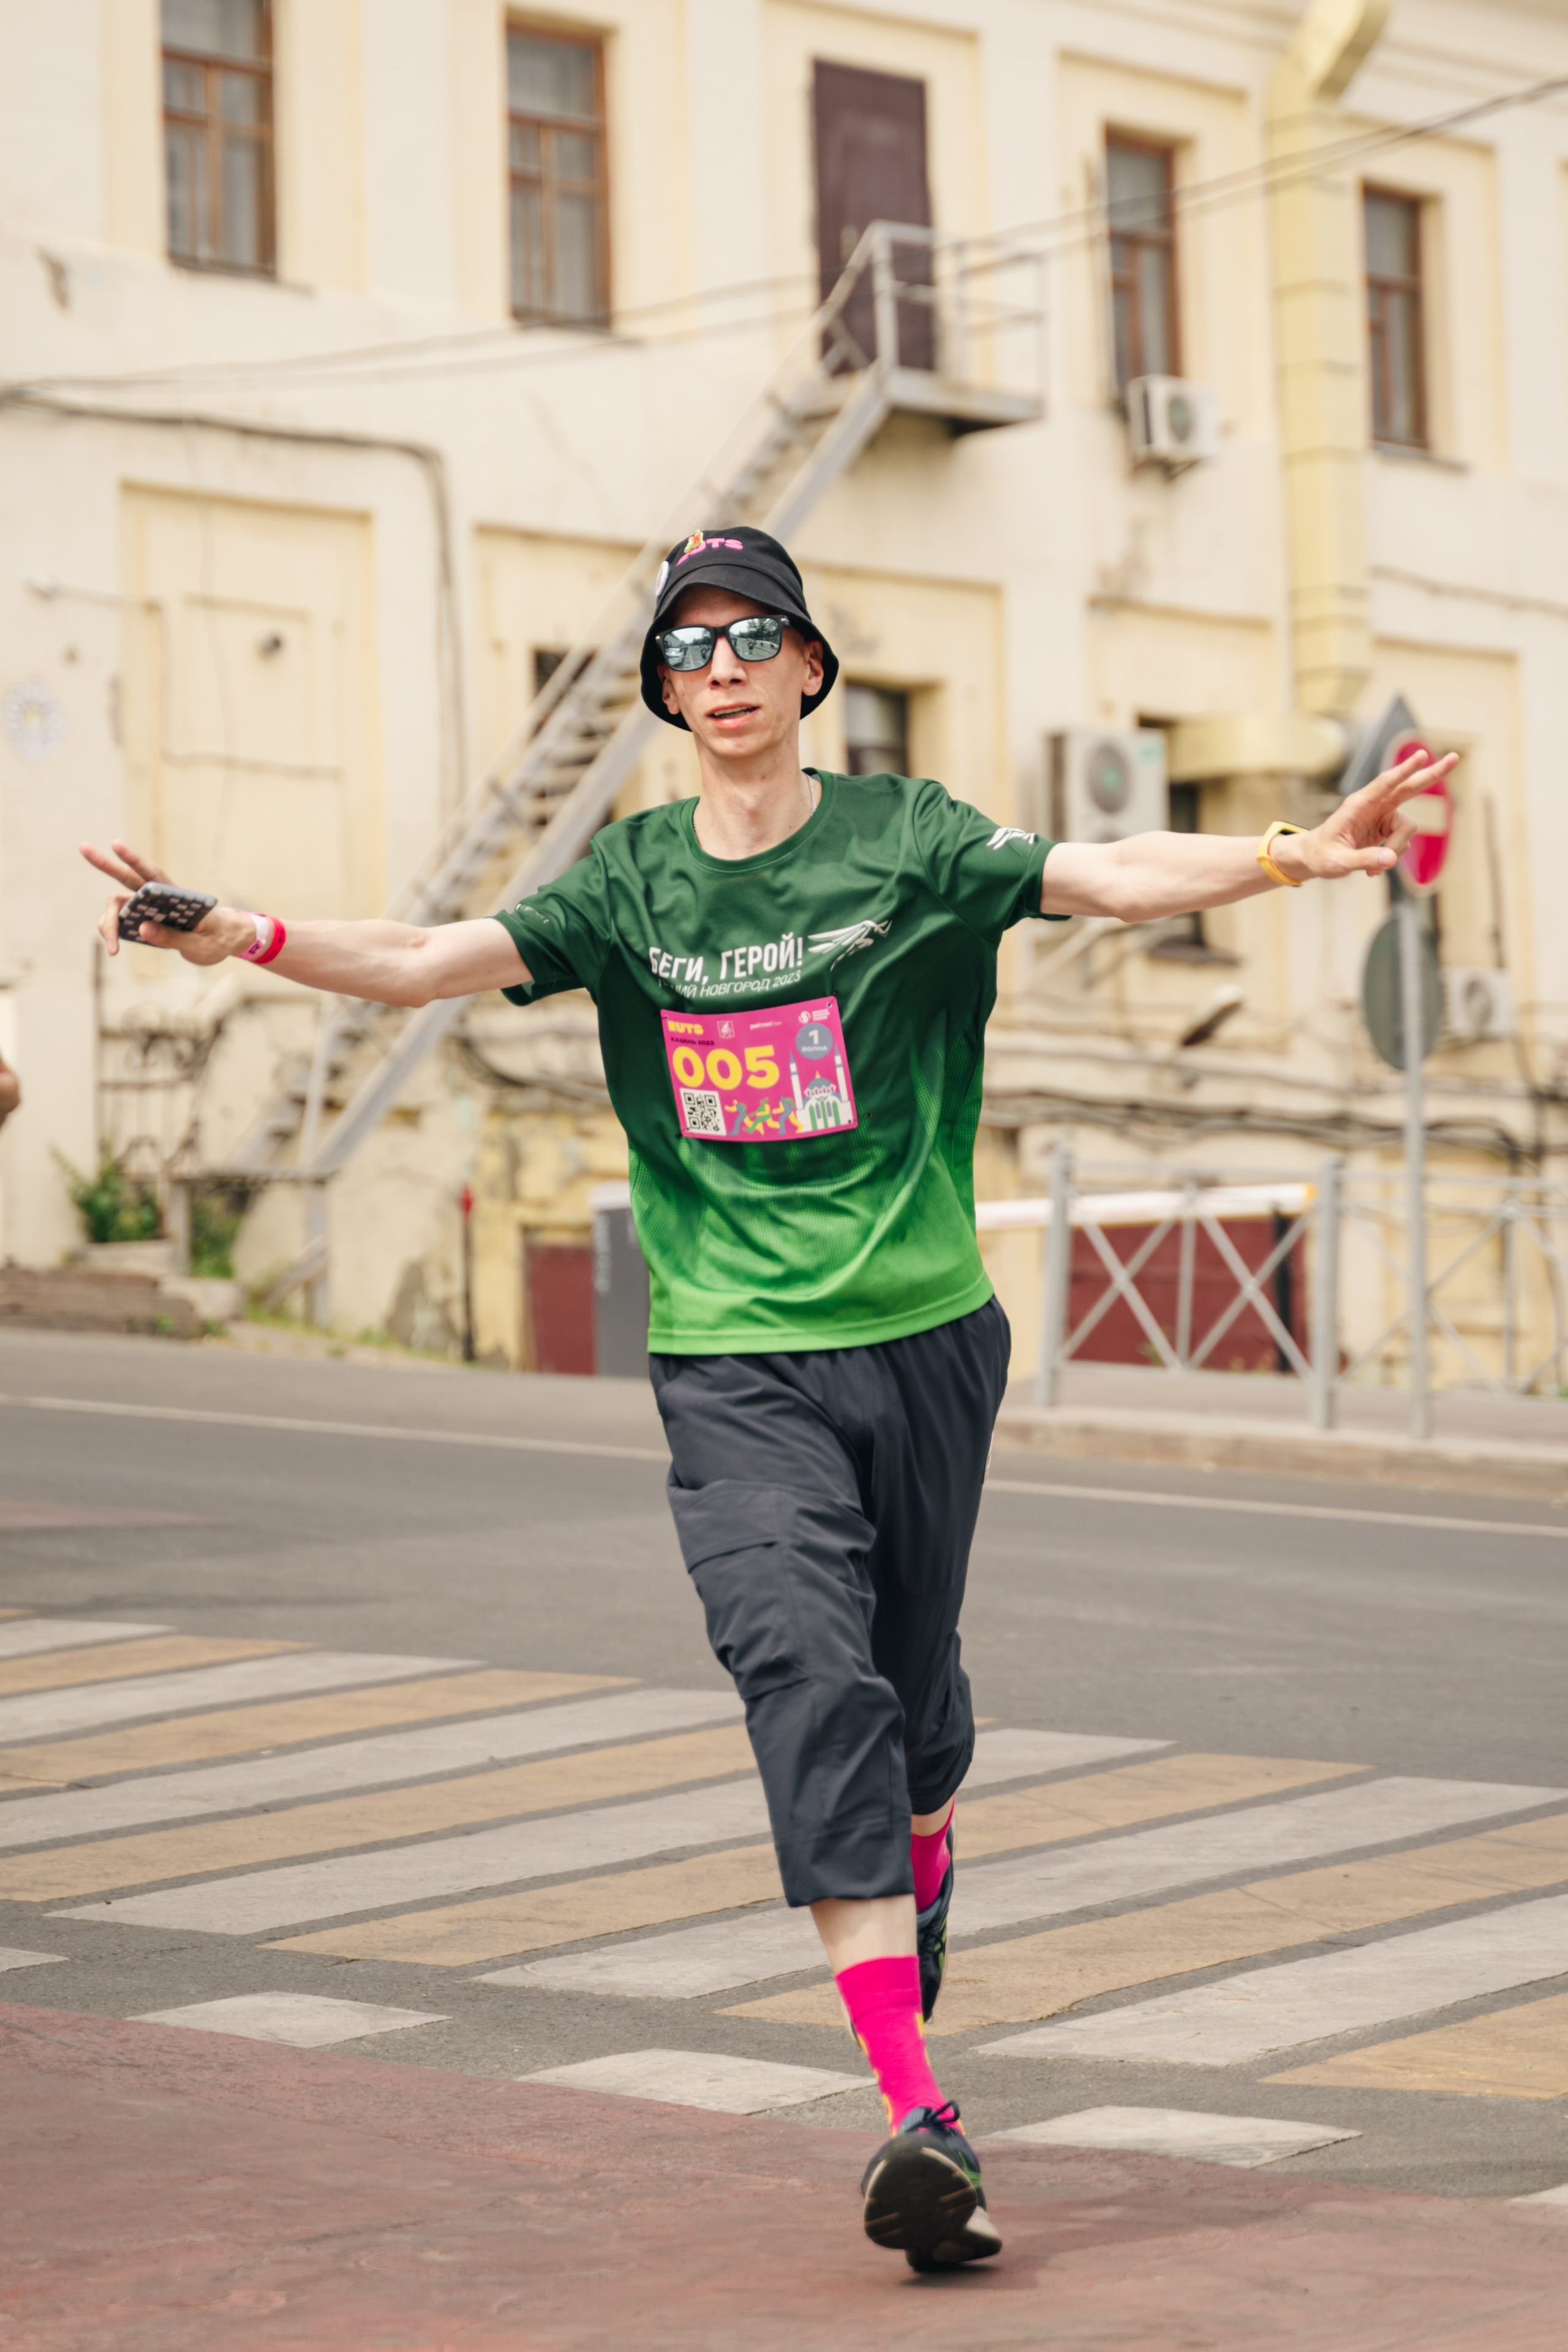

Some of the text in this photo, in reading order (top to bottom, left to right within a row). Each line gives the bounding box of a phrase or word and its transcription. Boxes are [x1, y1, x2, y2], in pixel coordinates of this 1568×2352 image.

[649, 932, 802, 985] БЕГИ, ГЕРОЙ!
[699, 978, 771, 997] НОВГОРОД
[772, 969, 801, 988] 2023
[668, 1020, 704, 1035] RUTS
[809, 1029, 819, 1046] 1
[671, 1036, 696, 1045] КАЗАНЬ
[673, 1045, 780, 1090] 005
